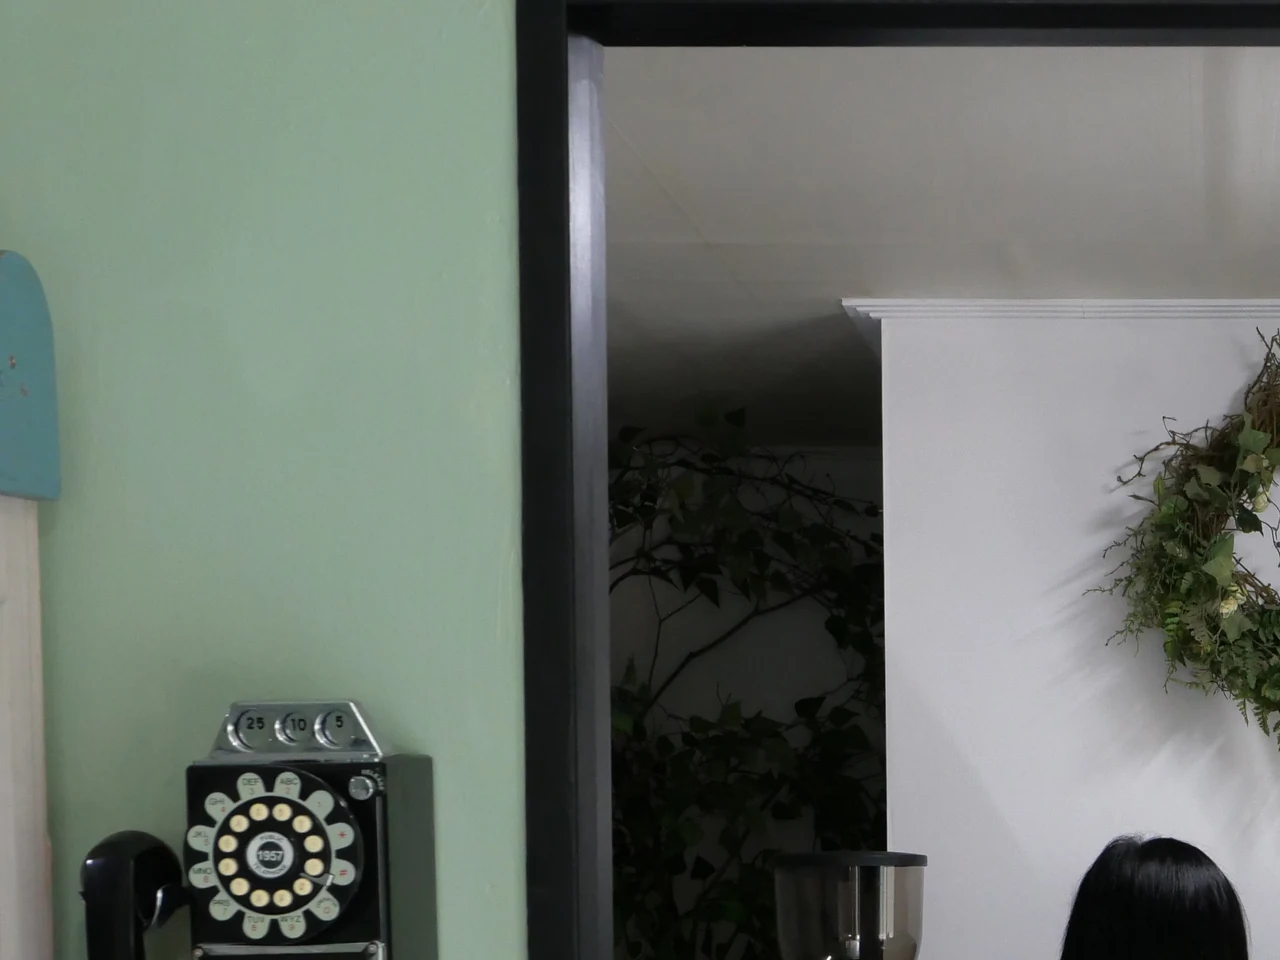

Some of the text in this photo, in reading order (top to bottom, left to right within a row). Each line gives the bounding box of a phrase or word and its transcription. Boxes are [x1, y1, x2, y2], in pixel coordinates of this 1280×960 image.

[246, 715, 344, 731] 25 10 5
[257, 850, 284, 861] 1957
